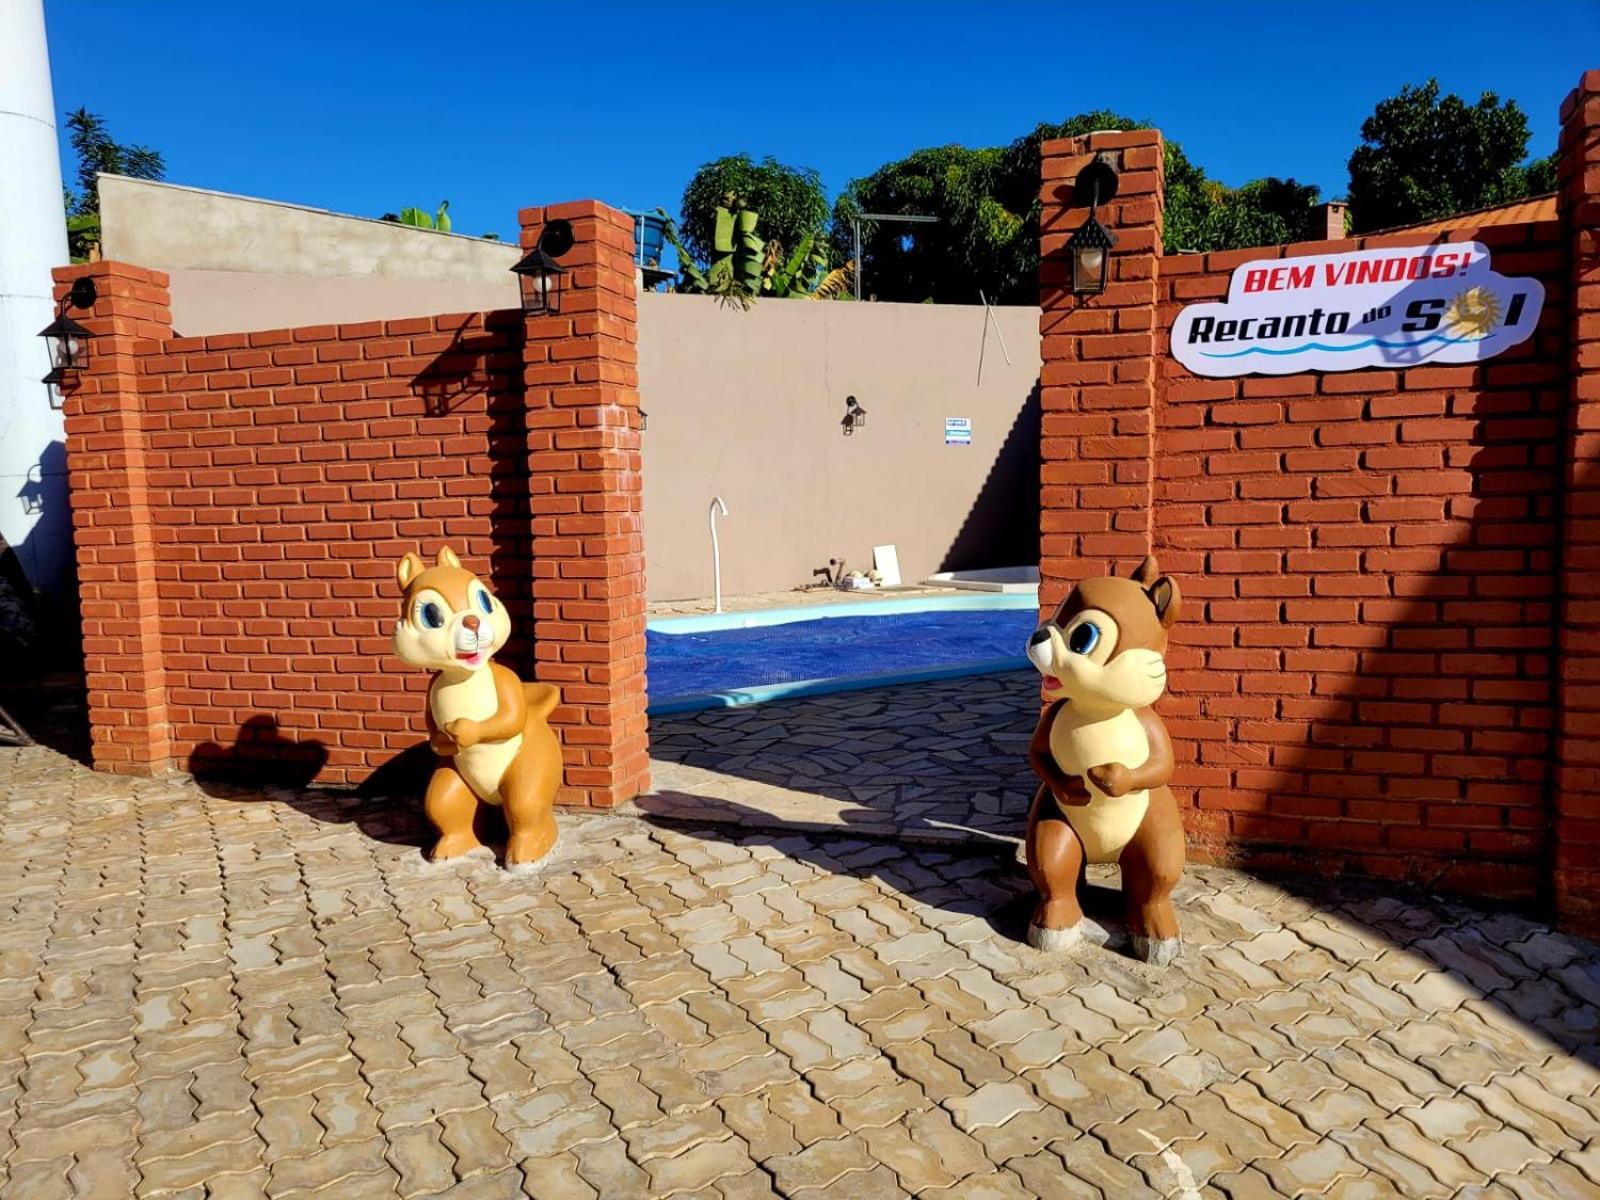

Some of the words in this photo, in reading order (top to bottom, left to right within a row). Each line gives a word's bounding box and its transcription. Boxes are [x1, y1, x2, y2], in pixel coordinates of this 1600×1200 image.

[1243, 264, 1316, 293] BEM
[1324, 252, 1472, 287] VINDOS!
[1187, 308, 1350, 344] Recanto
[1362, 305, 1392, 324] do
